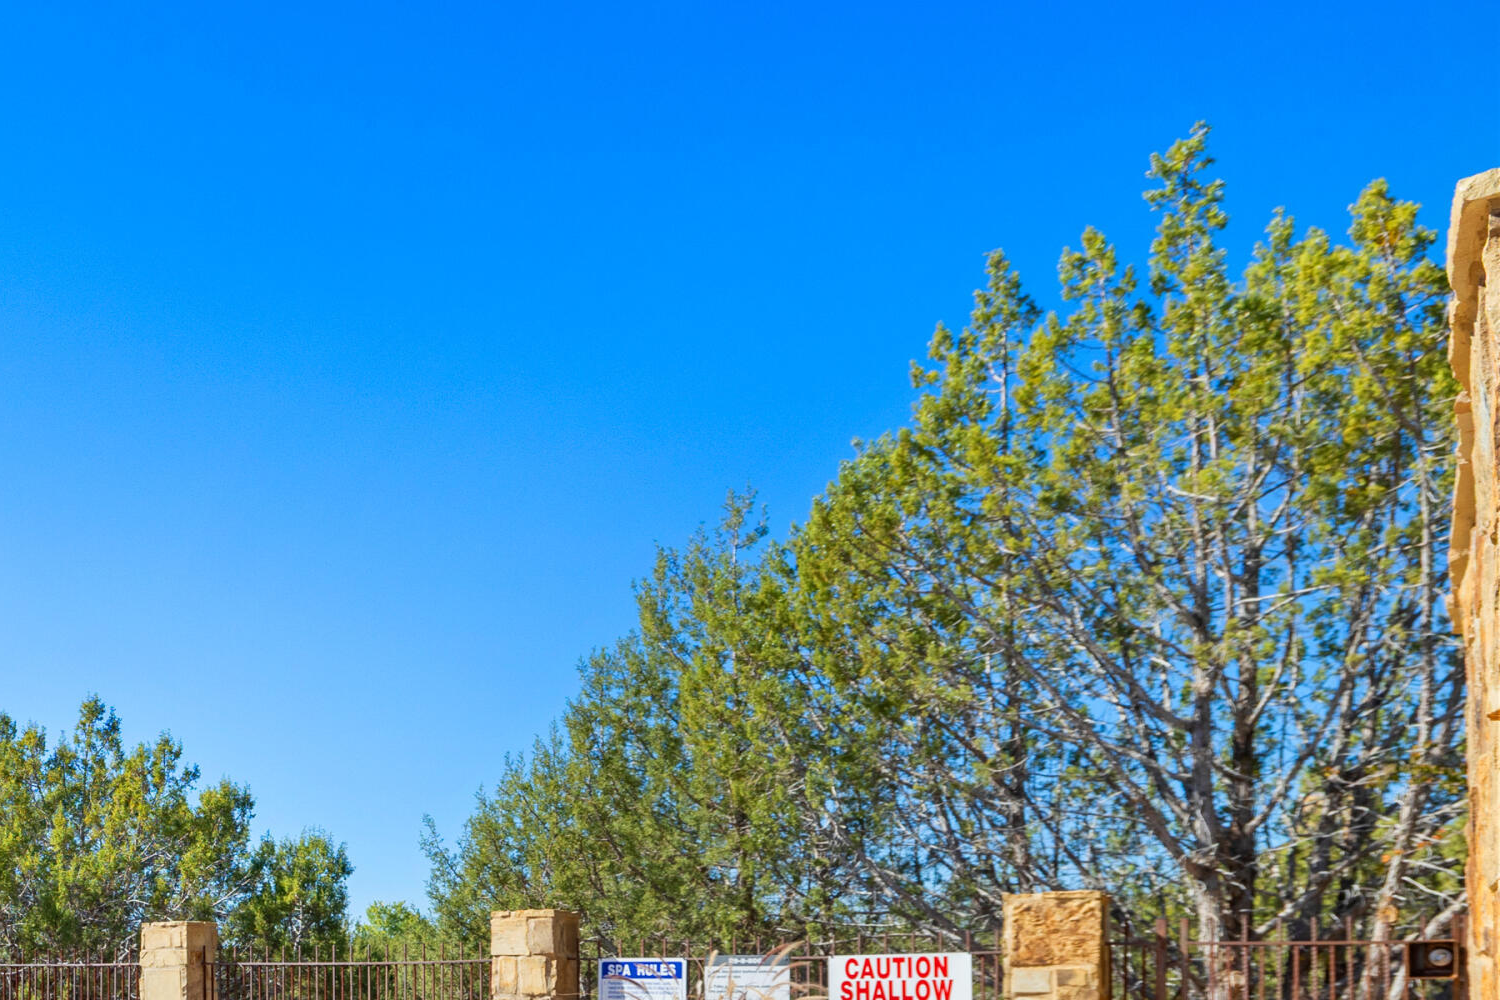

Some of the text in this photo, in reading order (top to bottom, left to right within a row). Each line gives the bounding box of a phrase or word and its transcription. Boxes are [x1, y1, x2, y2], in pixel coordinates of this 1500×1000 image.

[607, 963, 677, 976] SPA RULES
[844, 956, 949, 980] CAUTION
